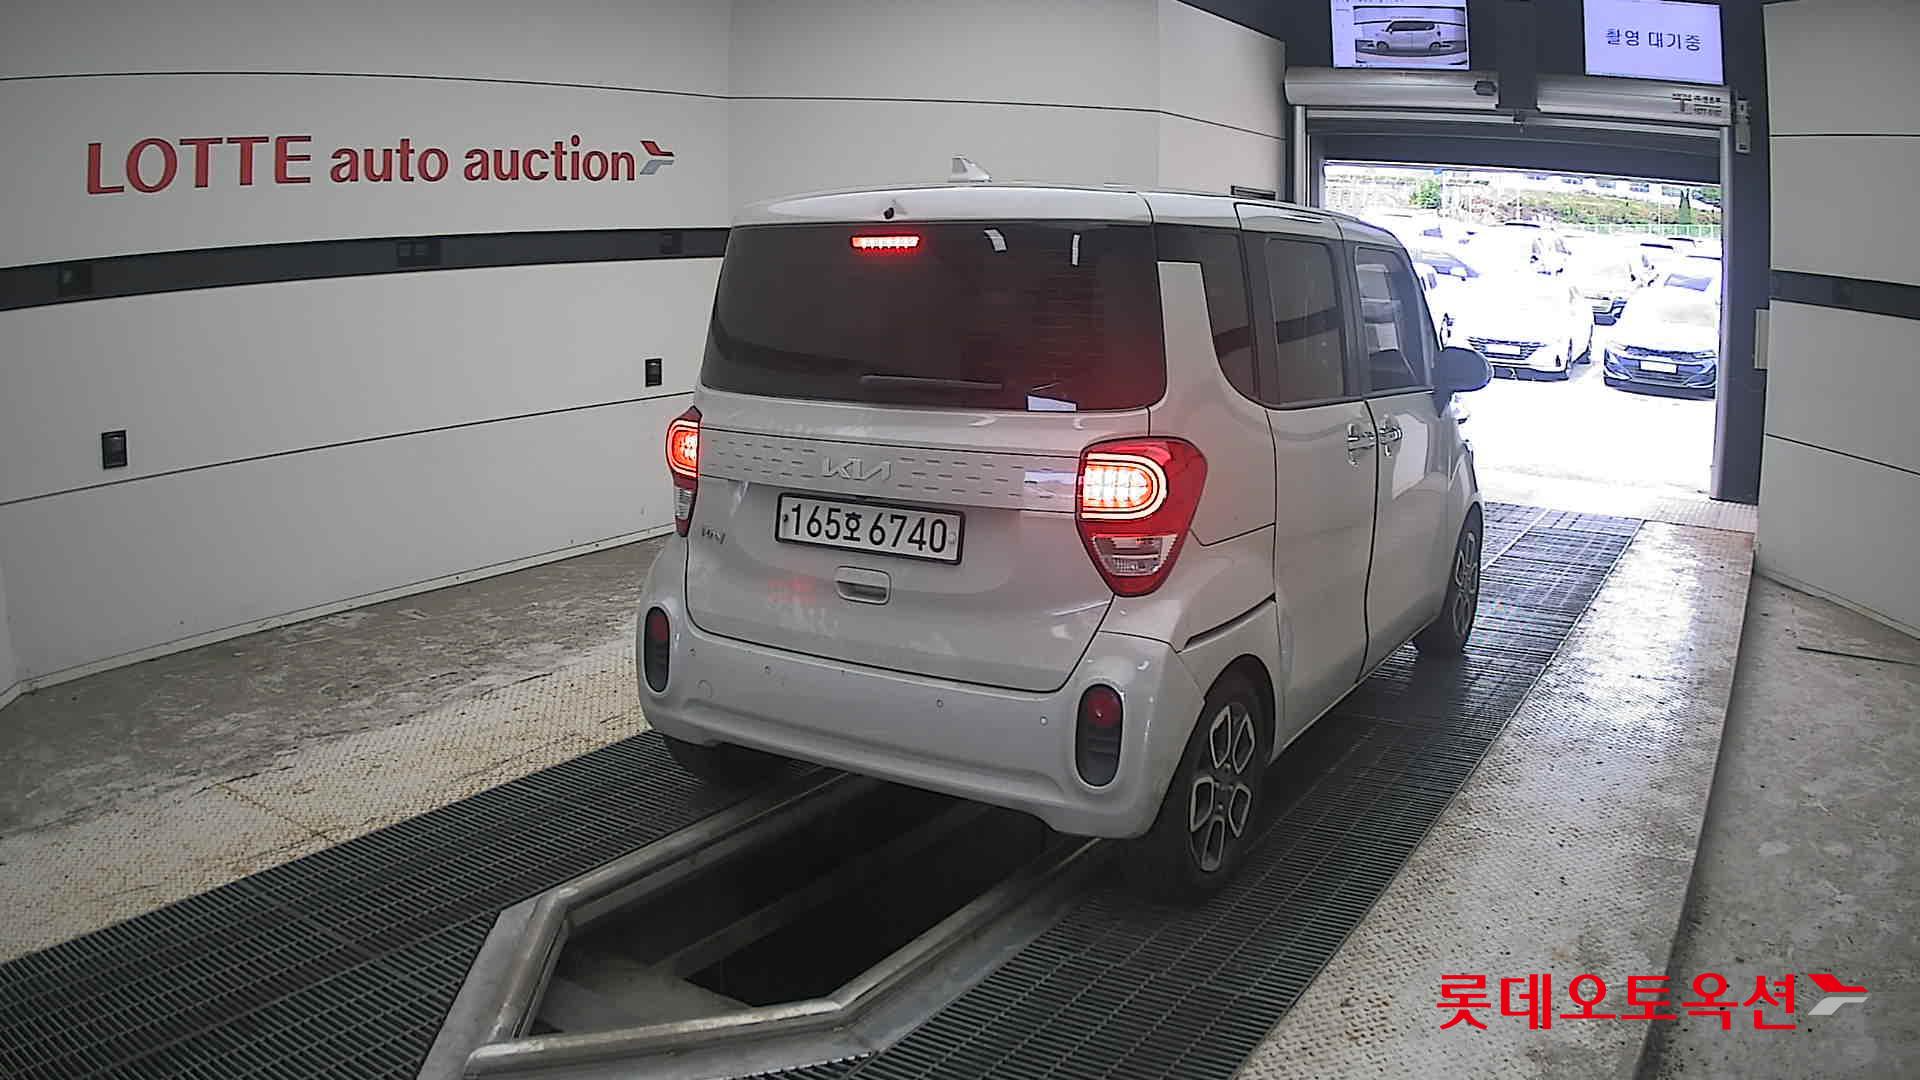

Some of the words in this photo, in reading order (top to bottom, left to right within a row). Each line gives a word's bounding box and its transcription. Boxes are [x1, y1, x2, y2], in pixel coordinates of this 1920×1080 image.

[1647, 31, 1701, 52] 대기중
[87, 135, 312, 195] LOTTE
[330, 138, 449, 183] auto
[463, 134, 635, 182] auction
[823, 455, 893, 481] KIA
[791, 503, 863, 543] 165호
[868, 512, 948, 554] 6740
